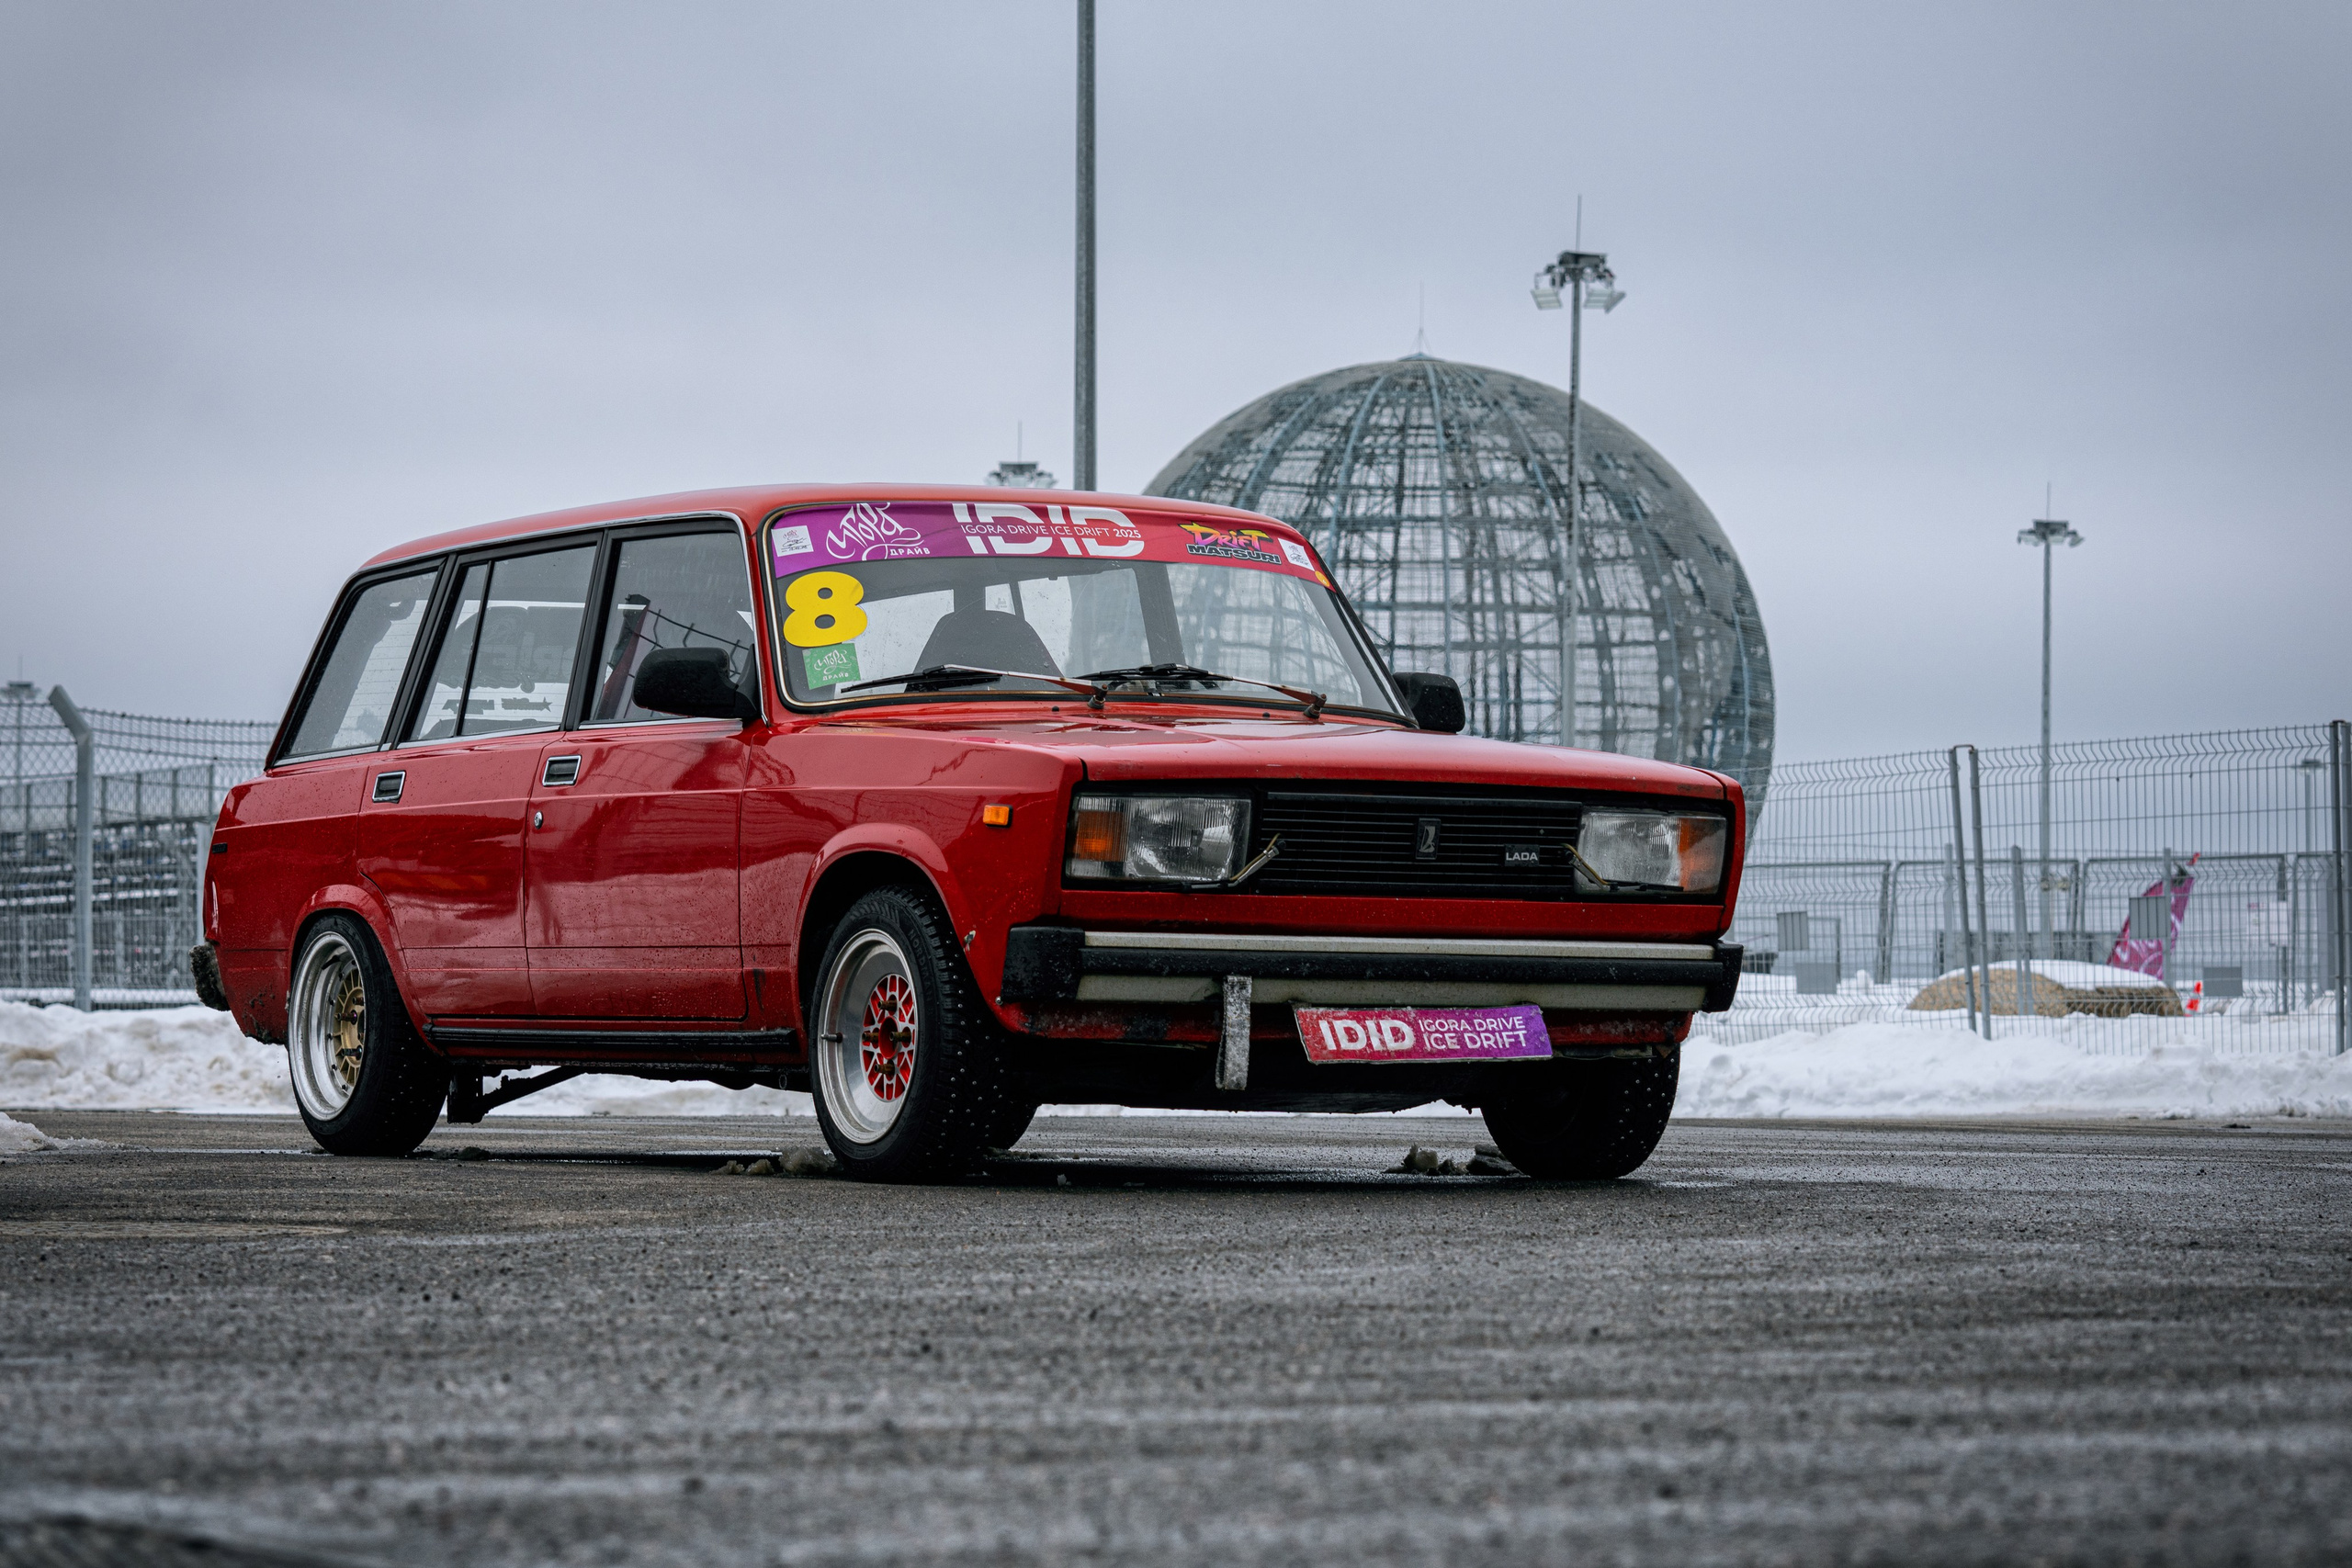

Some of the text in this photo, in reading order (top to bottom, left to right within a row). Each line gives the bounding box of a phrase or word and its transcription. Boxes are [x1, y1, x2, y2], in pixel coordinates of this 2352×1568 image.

[961, 525, 1142, 539] IGORA DRIVE ICE DRIFT 2025
[889, 547, 931, 556] ДРАЙВ
[1186, 544, 1282, 565] MATSURI
[784, 571, 867, 647] 8
[1506, 852, 1538, 861] LADA
[1419, 1017, 1527, 1032] IGORA DRIVE
[1319, 1020, 1416, 1051] IDID
[1423, 1031, 1528, 1050] ICE DRIFT
